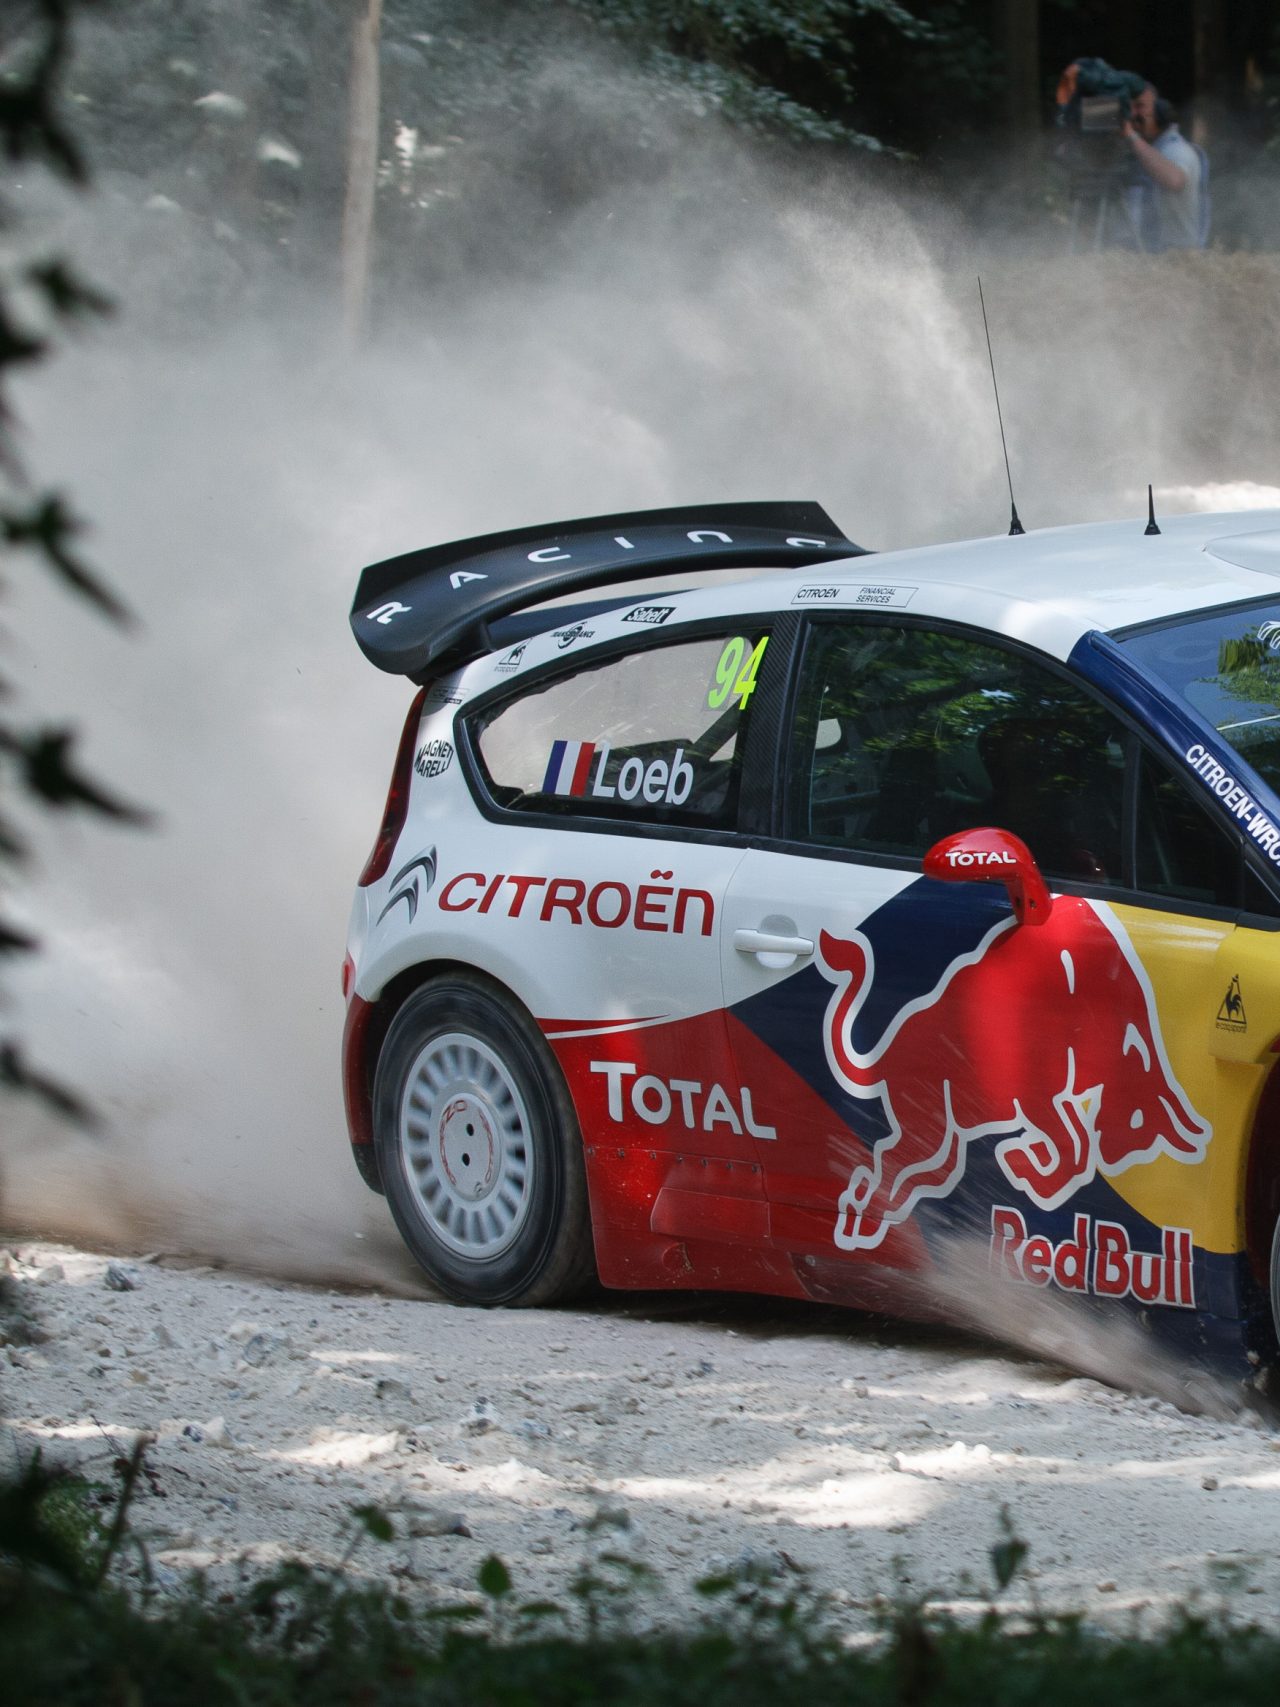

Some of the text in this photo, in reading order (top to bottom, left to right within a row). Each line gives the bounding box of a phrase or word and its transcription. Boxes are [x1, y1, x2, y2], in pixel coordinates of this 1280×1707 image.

[797, 588, 840, 599] CITROËN
[855, 595, 892, 604] SERVICES
[859, 587, 897, 596] FINANCIAL
[708, 636, 769, 710] 94
[592, 741, 695, 806] Loeb
[944, 849, 1018, 868] TOTAL
[438, 868, 715, 937] CITROËN
[589, 1060, 778, 1141] TOTAL
[989, 1204, 1197, 1310] Red Bull
